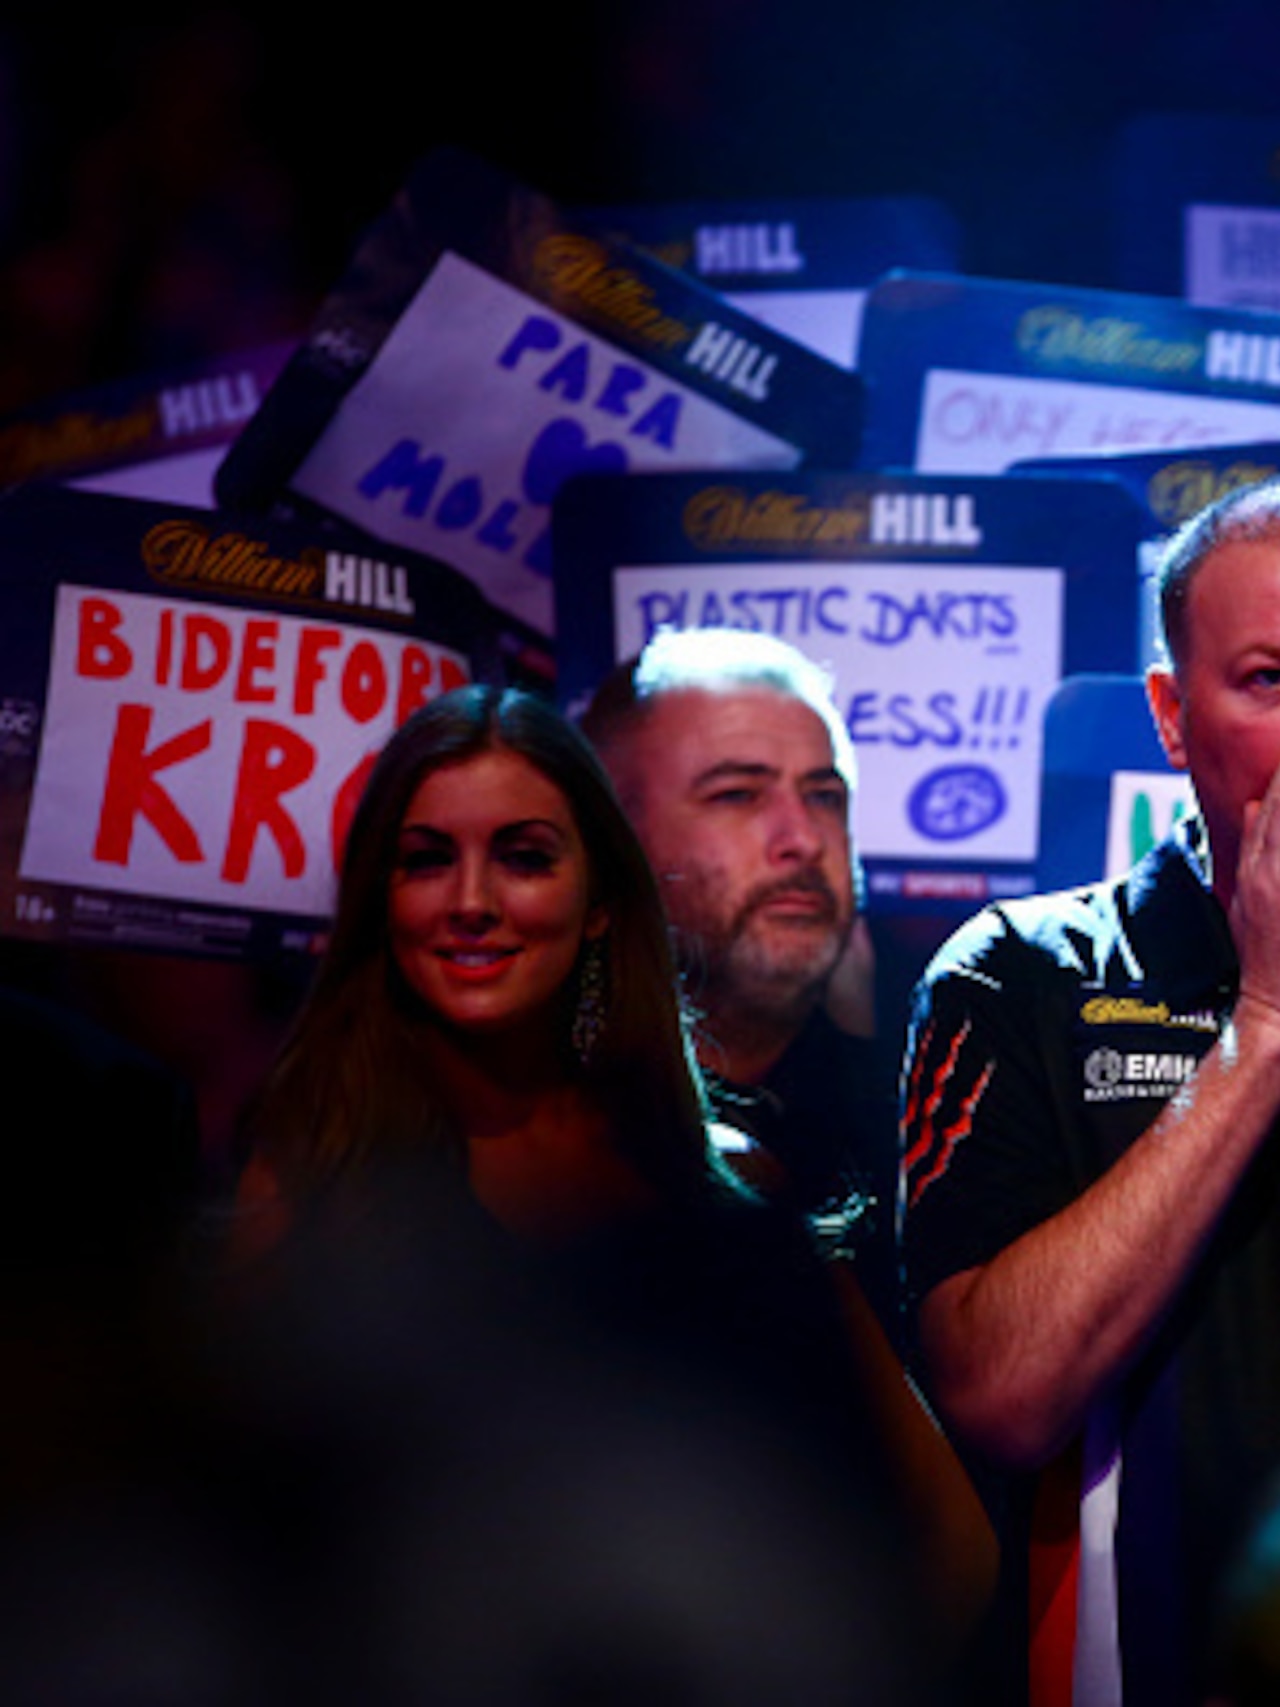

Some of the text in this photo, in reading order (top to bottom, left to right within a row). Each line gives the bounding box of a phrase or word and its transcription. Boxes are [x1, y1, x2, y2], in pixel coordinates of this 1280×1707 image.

[694, 220, 804, 276] HILL
[683, 321, 782, 403] HILL
[1014, 304, 1202, 376] William
[682, 483, 983, 556] William HILL
[140, 518, 416, 617] William HILL
[638, 585, 1018, 647] PLASTIC DARTS
[93, 704, 374, 883] KR
